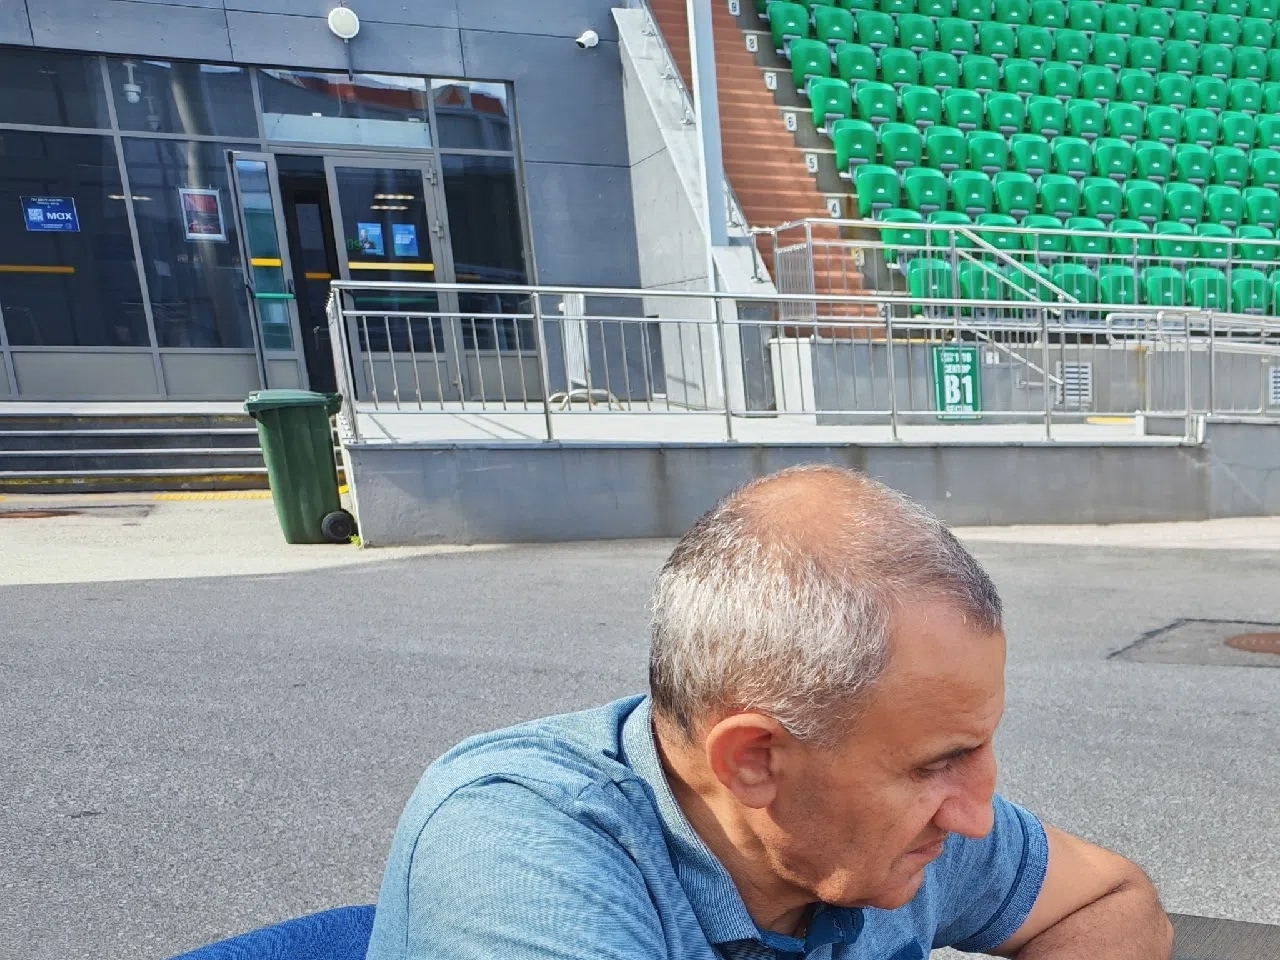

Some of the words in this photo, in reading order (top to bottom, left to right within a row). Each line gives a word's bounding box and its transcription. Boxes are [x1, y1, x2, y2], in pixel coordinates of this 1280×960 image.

[767, 75, 774, 87] 7
[808, 157, 815, 169] 5
[831, 201, 838, 215] 4
[944, 375, 973, 403] B1
